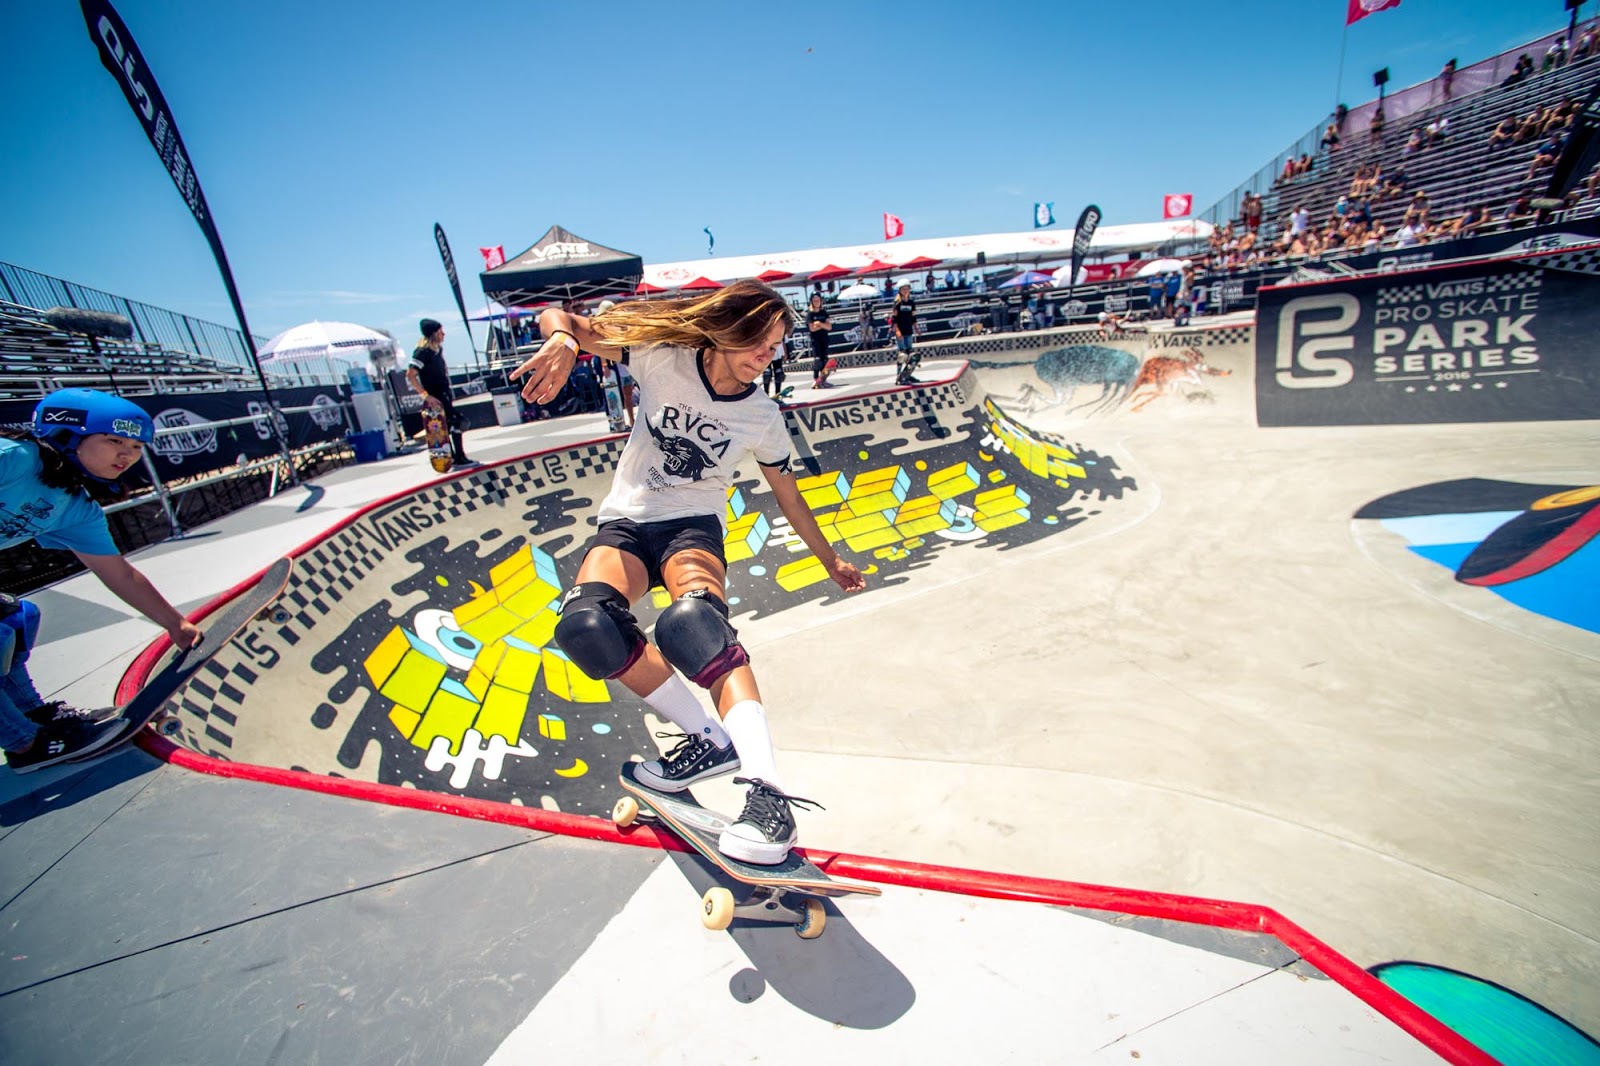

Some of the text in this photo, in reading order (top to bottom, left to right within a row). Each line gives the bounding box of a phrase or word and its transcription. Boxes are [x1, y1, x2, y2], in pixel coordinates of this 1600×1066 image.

[1425, 278, 1486, 300] VANS
[1375, 292, 1540, 324] PRO SKATE
[1373, 313, 1537, 354] PARK
[1373, 346, 1540, 373] SERIES
[678, 402, 693, 413] THE
[796, 401, 865, 432] VANS
[661, 405, 732, 460] RVCA
[357, 496, 435, 551] VANS
